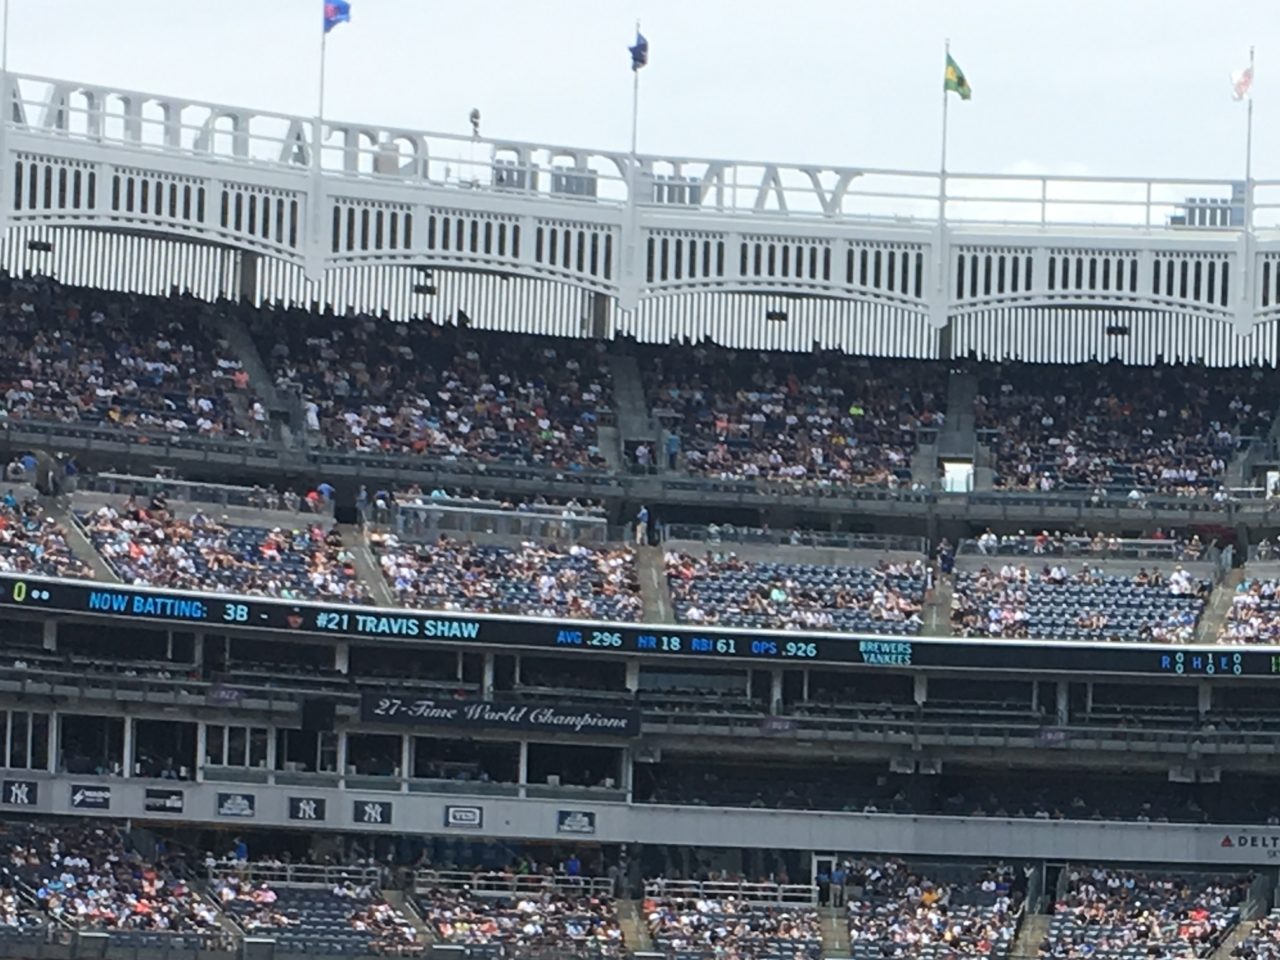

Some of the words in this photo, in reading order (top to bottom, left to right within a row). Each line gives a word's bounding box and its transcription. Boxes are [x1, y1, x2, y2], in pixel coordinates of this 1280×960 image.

[89, 591, 129, 612] NOW
[133, 598, 207, 618] BATTING:
[223, 604, 249, 621] 3B
[316, 612, 348, 630] #21
[355, 615, 419, 635] TRAVIS
[424, 621, 480, 639] SHAW
[556, 630, 583, 644] AVG
[586, 631, 623, 647] .296
[637, 635, 657, 649] HR
[661, 636, 681, 651] 18
[691, 638, 713, 651] RBI
[716, 638, 736, 654] 61
[751, 640, 777, 655] OPS
[781, 642, 817, 657] .926
[858, 641, 912, 654] BREWERS
[862, 654, 912, 665] YANKEES
[374, 698, 457, 719] 27-Time
[464, 703, 528, 722] World
[529, 708, 628, 732] Champions
